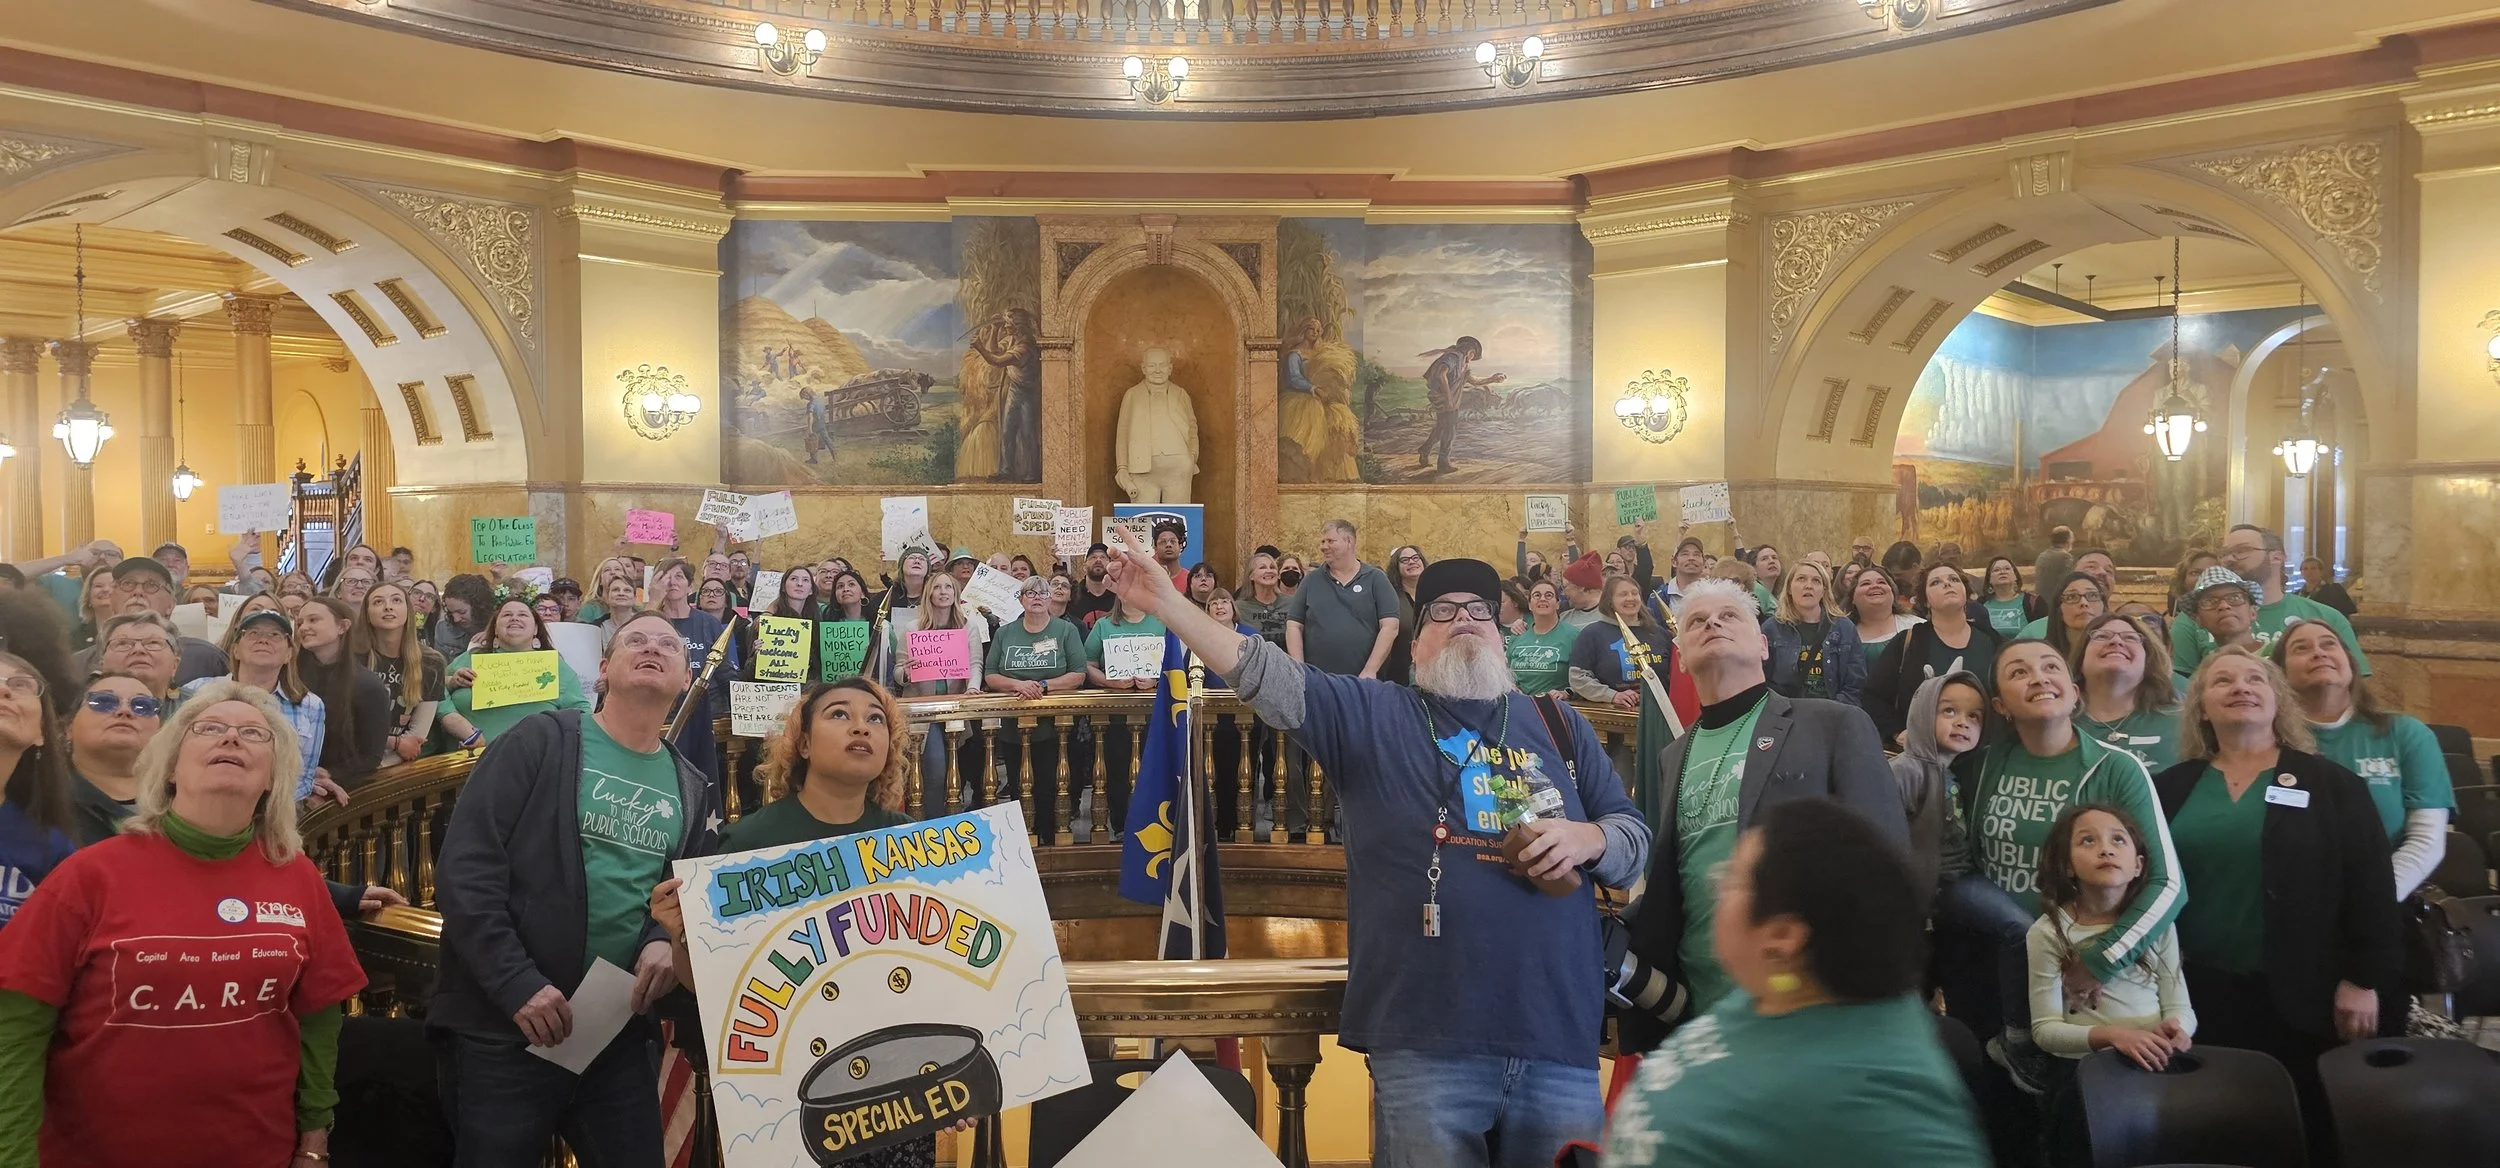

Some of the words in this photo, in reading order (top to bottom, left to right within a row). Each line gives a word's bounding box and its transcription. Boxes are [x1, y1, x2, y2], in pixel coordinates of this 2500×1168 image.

[706, 490, 747, 506] FULLY
[1019, 499, 1054, 510] FULLY
[1684, 497, 1713, 511] lucky
[703, 503, 739, 515] FUND
[1022, 511, 1054, 520] FUND
[1059, 509, 1088, 518] PUBLIC
[1021, 521, 1055, 531] SPED!
[1060, 525, 1086, 533] NEED
[1058, 532, 1089, 540] MENTAL
[476, 549, 536, 564] LEGISLATORS!
[766, 624, 800, 643] Lucky
[826, 626, 865, 639] PUBLIC
[911, 632, 955, 645] Protect
[771, 637, 785, 646] to
[824, 640, 864, 651] MONEY
[1108, 640, 1164, 655] Inclusion
[834, 651, 852, 661] FOR
[911, 645, 944, 657] Public
[1129, 653, 1140, 662] is
[769, 659, 789, 667] ALL
[911, 656, 958, 670] Education
[1652, 653, 1663, 664] be
[825, 660, 864, 672] PUBLIC
[1108, 663, 1160, 678] Beautifu
[732, 683, 751, 693] OUR
[754, 684, 798, 693] STUDENTS
[735, 694, 752, 703] ARE
[755, 694, 773, 702] NOT
[732, 713, 753, 722] THEY
[1467, 739, 1503, 765] One
[1997, 773, 2071, 801] UBLIC
[592, 778, 660, 826] lucky
[610, 804, 618, 817] TO
[1706, 796, 1739, 822] SCHOO
[582, 811, 620, 839] PUBLIC
[622, 823, 670, 850] SCHOOLS
[1983, 815, 2017, 841] OR
[1981, 836, 2040, 868] UBLI
[718, 847, 851, 917] IRISH
[855, 820, 981, 884] KANSAS
[136, 951, 168, 964] Capital
[179, 952, 200, 963] Area
[211, 951, 241, 962] Retired
[252, 948, 288, 959] Educators
[727, 916, 827, 1062] FULLY
[826, 892, 1001, 968] FUNDED
[129, 984, 160, 1011] C.
[174, 984, 206, 1011] A.
[221, 981, 246, 1008] R.
[256, 978, 278, 1002] E.
[822, 1096, 924, 1151] SPECIAL
[924, 1080, 970, 1120] ED
